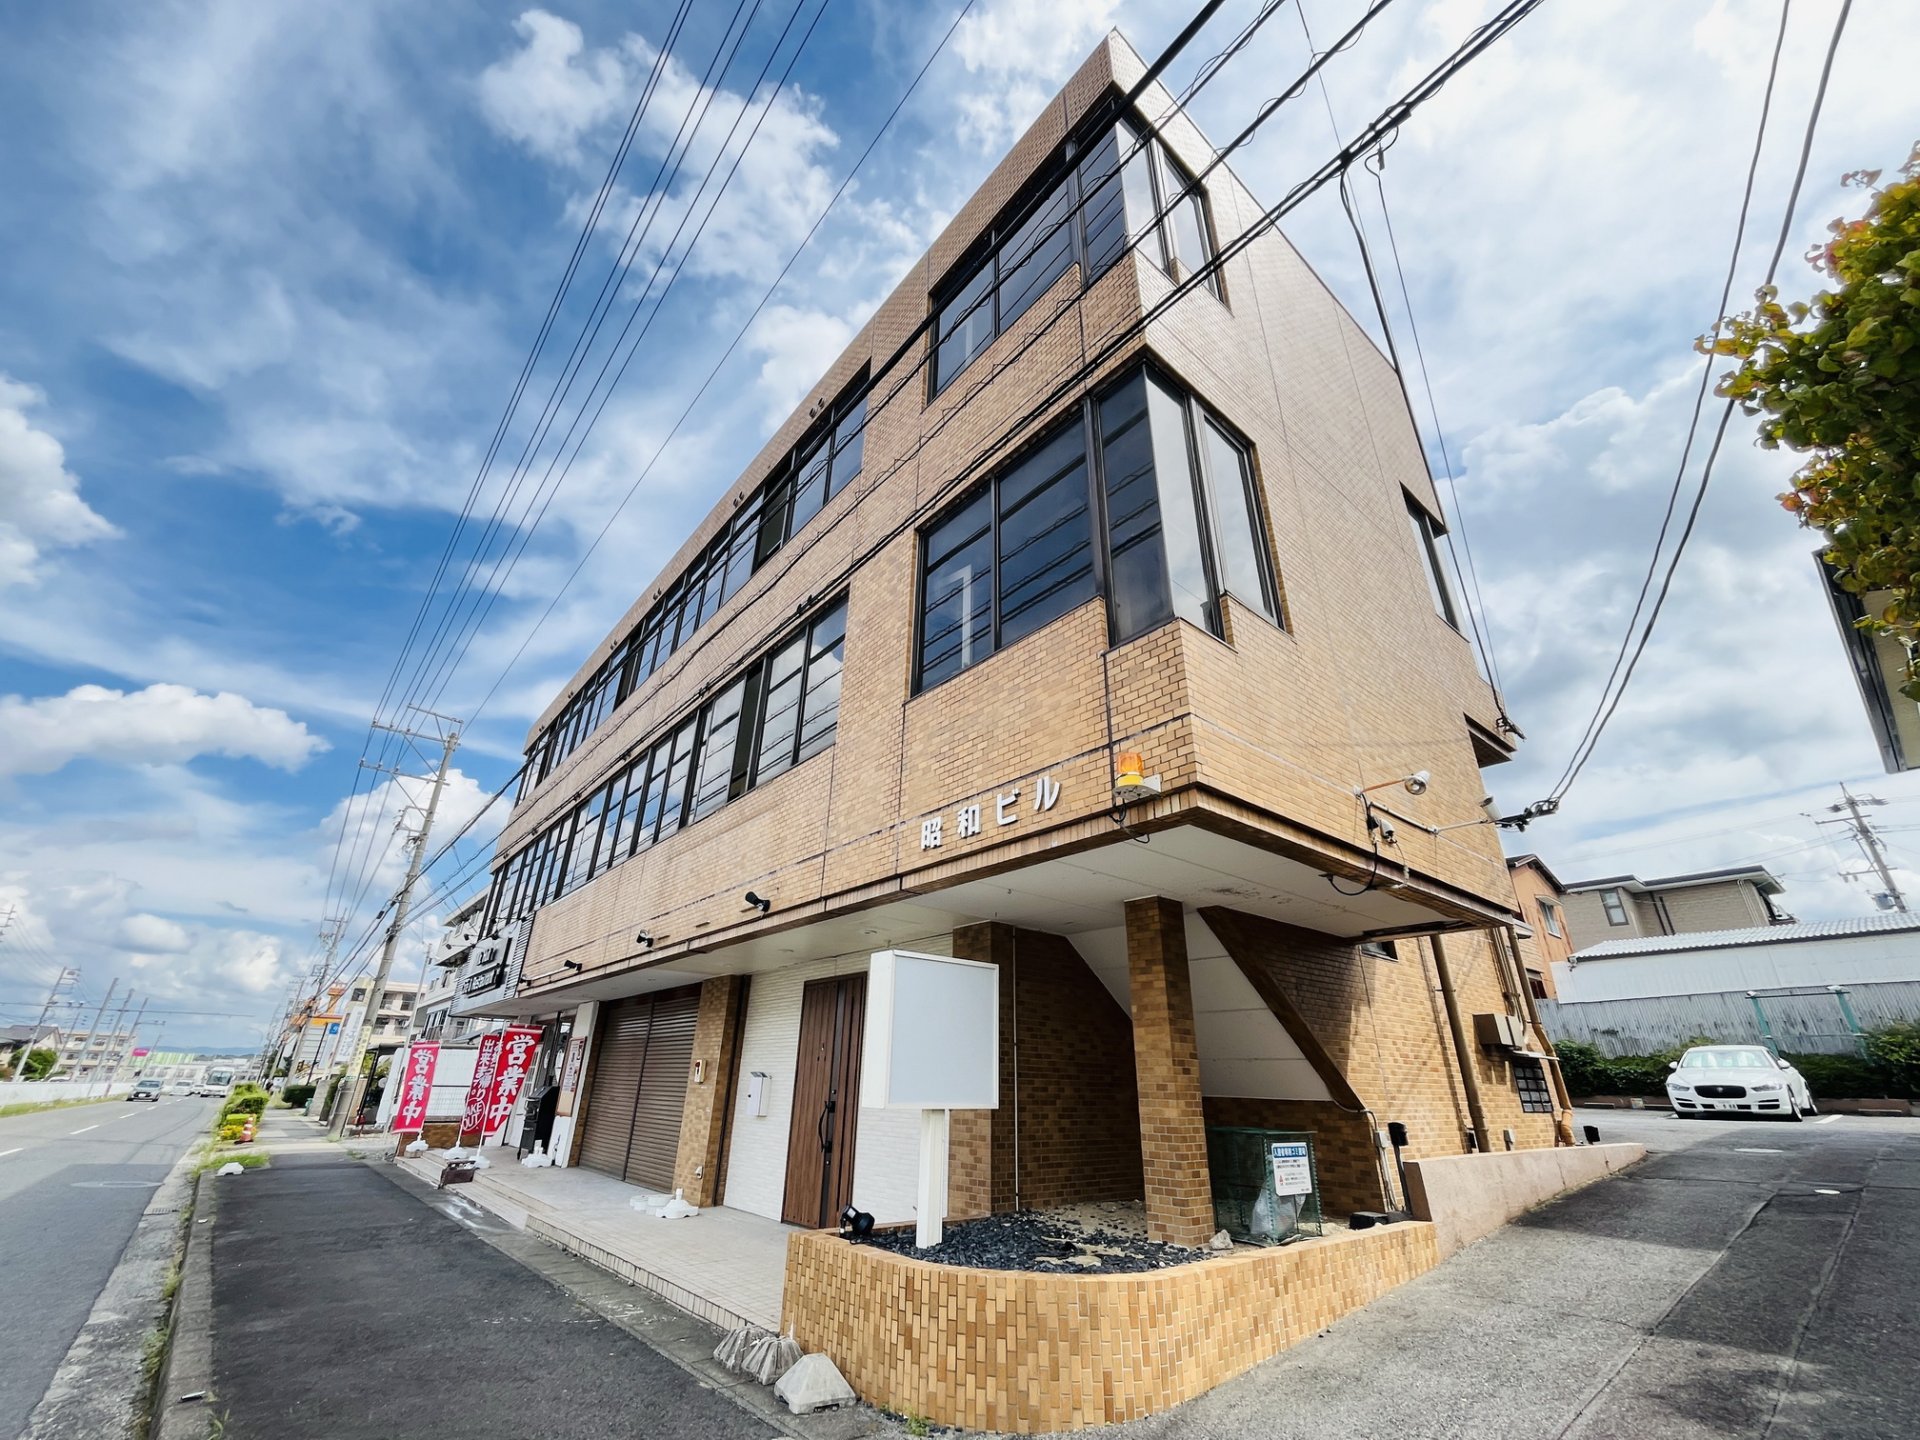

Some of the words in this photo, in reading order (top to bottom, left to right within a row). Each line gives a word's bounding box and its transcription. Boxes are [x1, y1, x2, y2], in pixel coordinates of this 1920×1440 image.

[921, 776, 1060, 850] 昭和ビル
[402, 1049, 434, 1126] 営業中
[466, 1102, 482, 1116] AKE
[490, 1034, 535, 1127] 営業中
